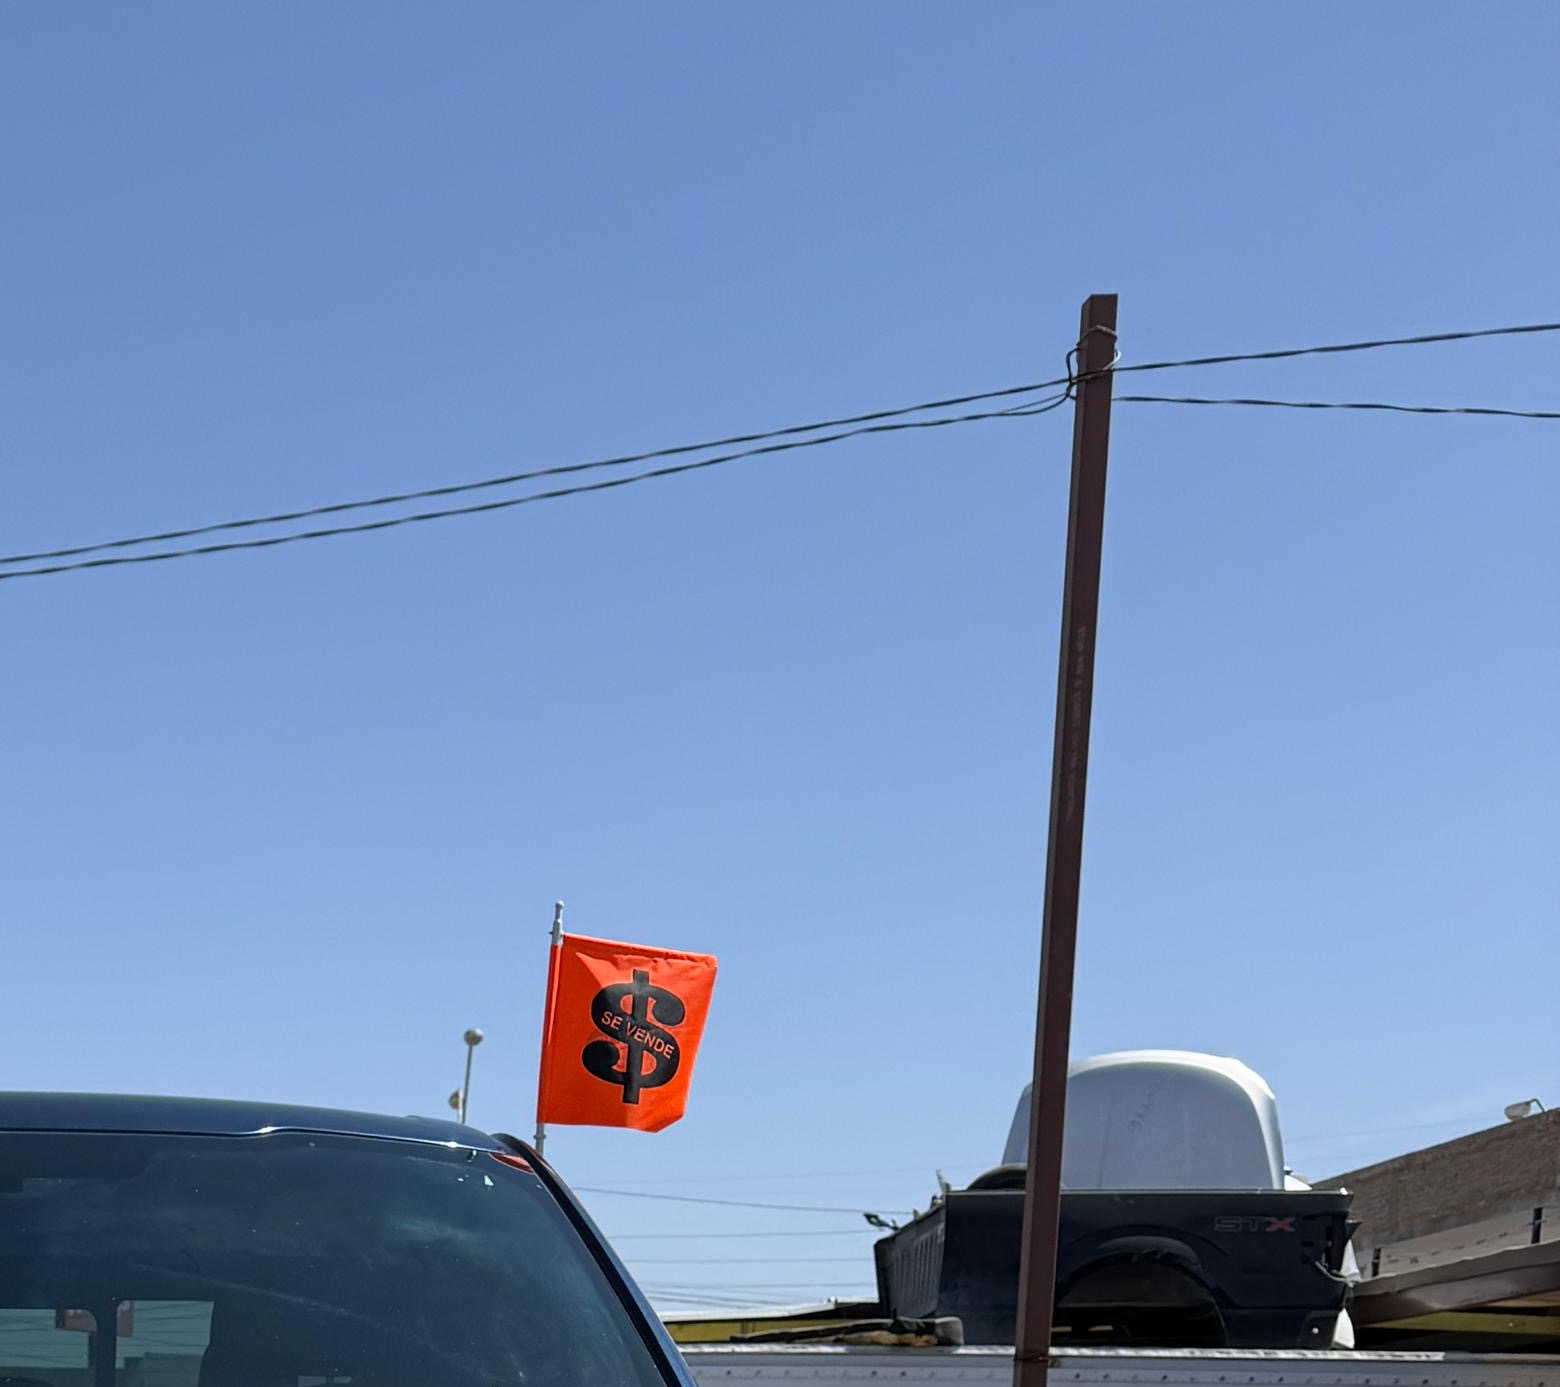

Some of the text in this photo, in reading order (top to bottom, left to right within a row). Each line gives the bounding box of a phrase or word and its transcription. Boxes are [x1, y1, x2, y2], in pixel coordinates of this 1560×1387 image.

[601, 1011, 675, 1059] SE VENDE
[1214, 1215, 1296, 1233] STX
